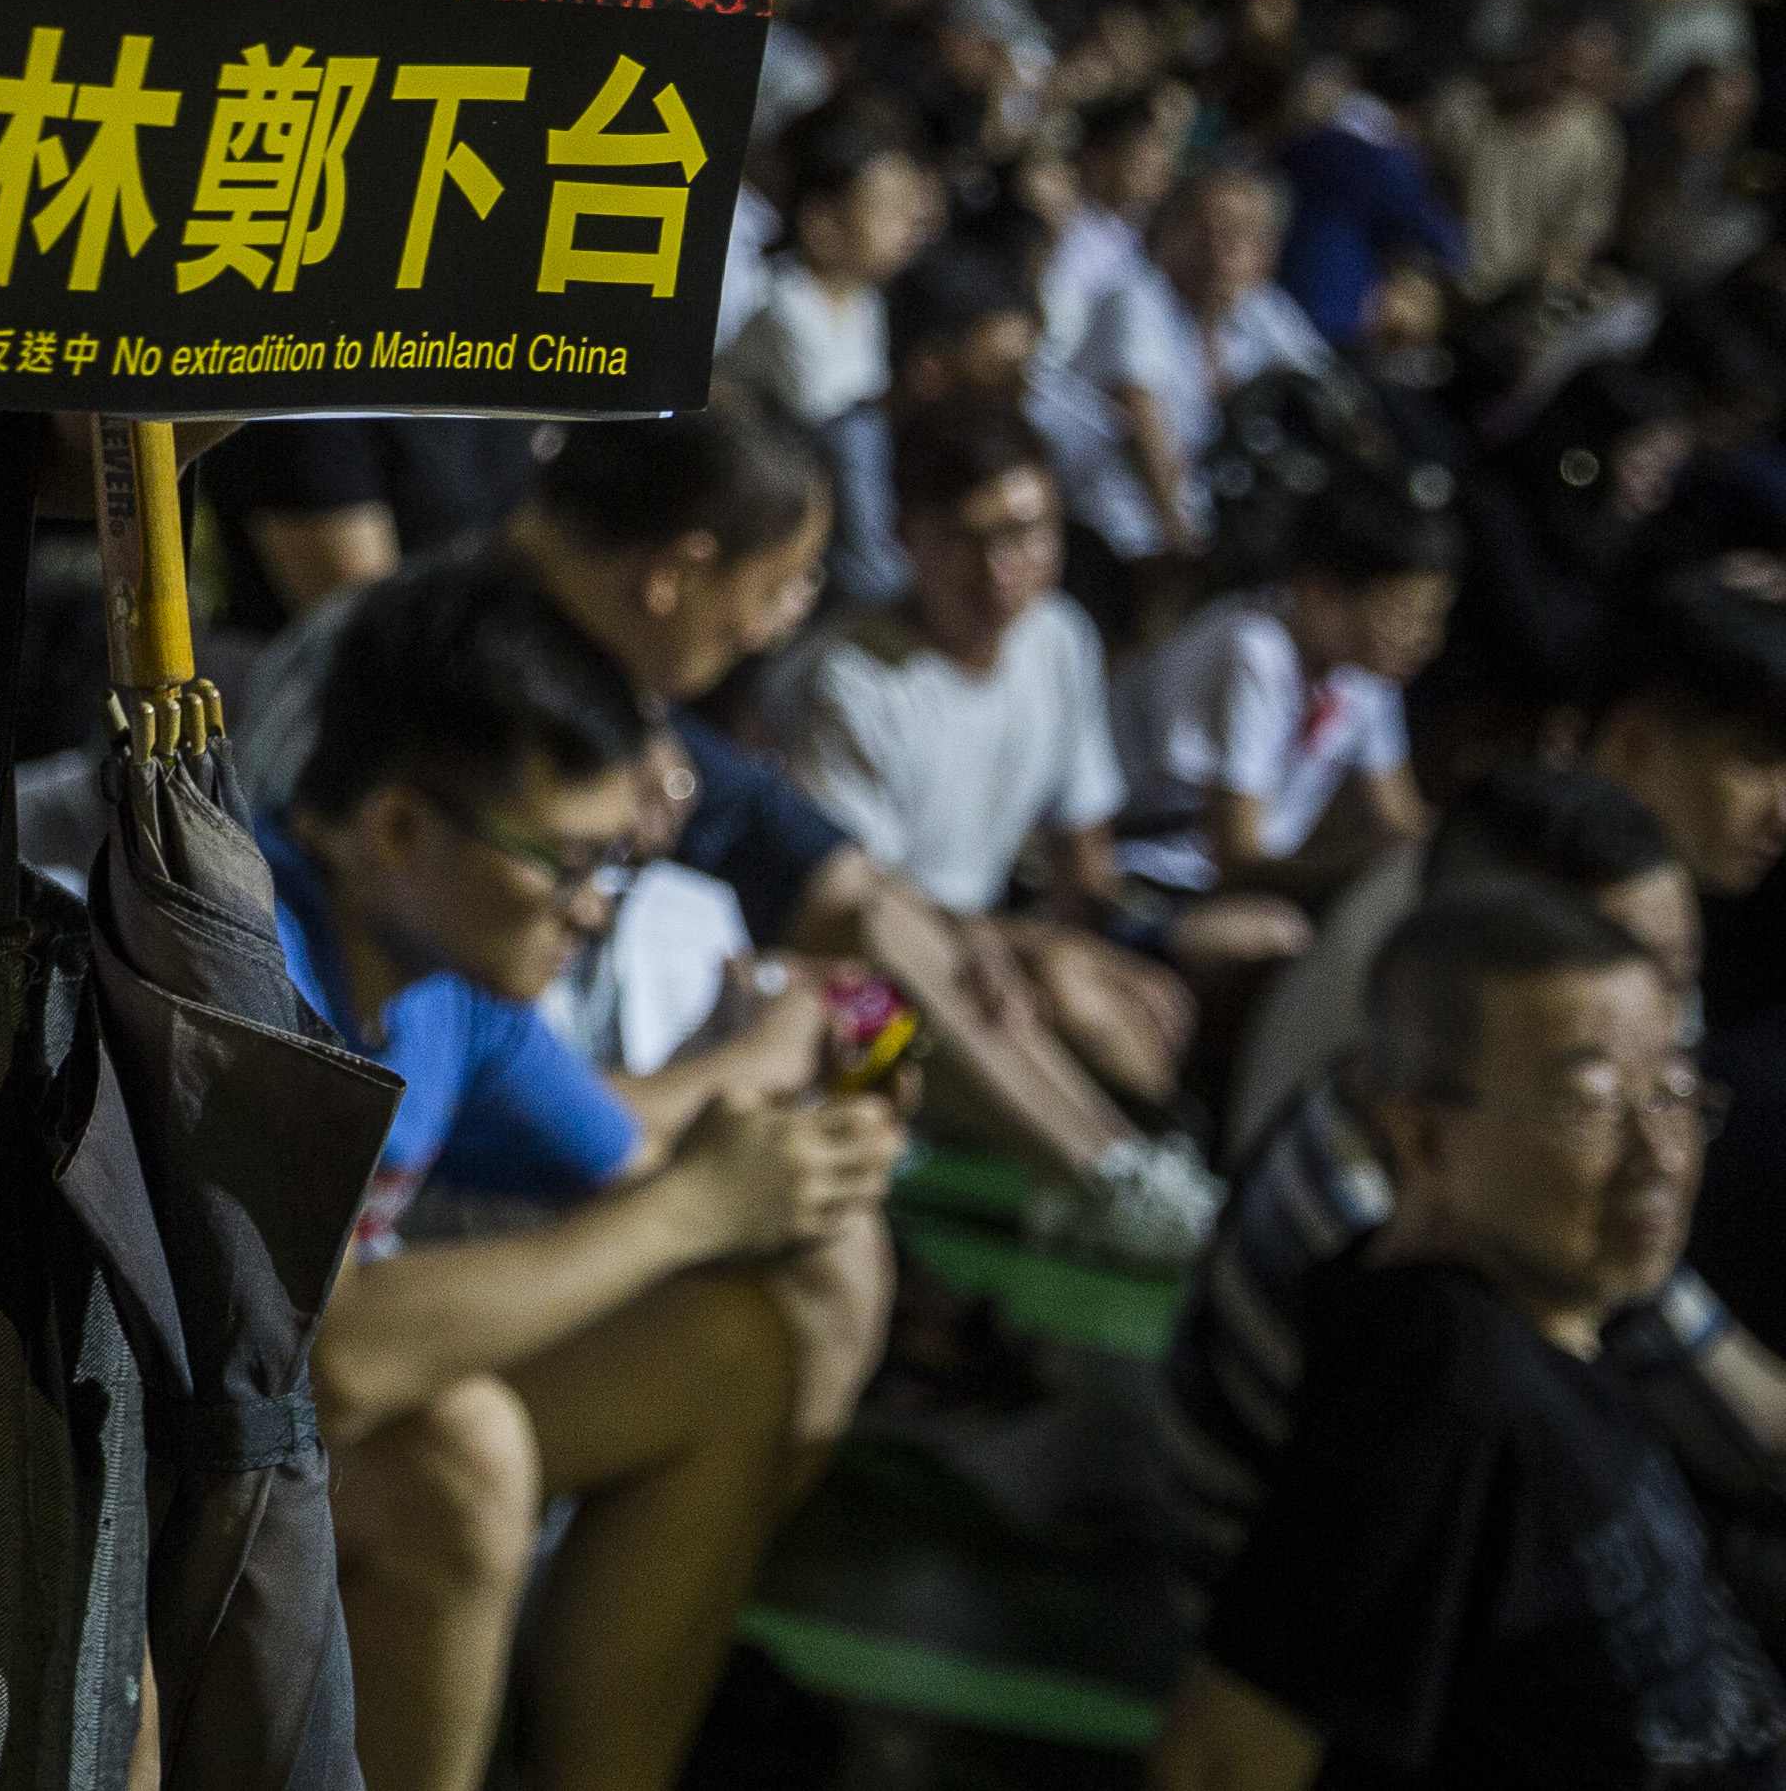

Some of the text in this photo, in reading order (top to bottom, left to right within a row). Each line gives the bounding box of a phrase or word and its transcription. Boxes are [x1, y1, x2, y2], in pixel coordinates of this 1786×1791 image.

[111, 336, 163, 377] No
[170, 333, 327, 377] extradition
[333, 336, 364, 371] to
[369, 330, 519, 371] Mainland
[527, 333, 628, 376] China
